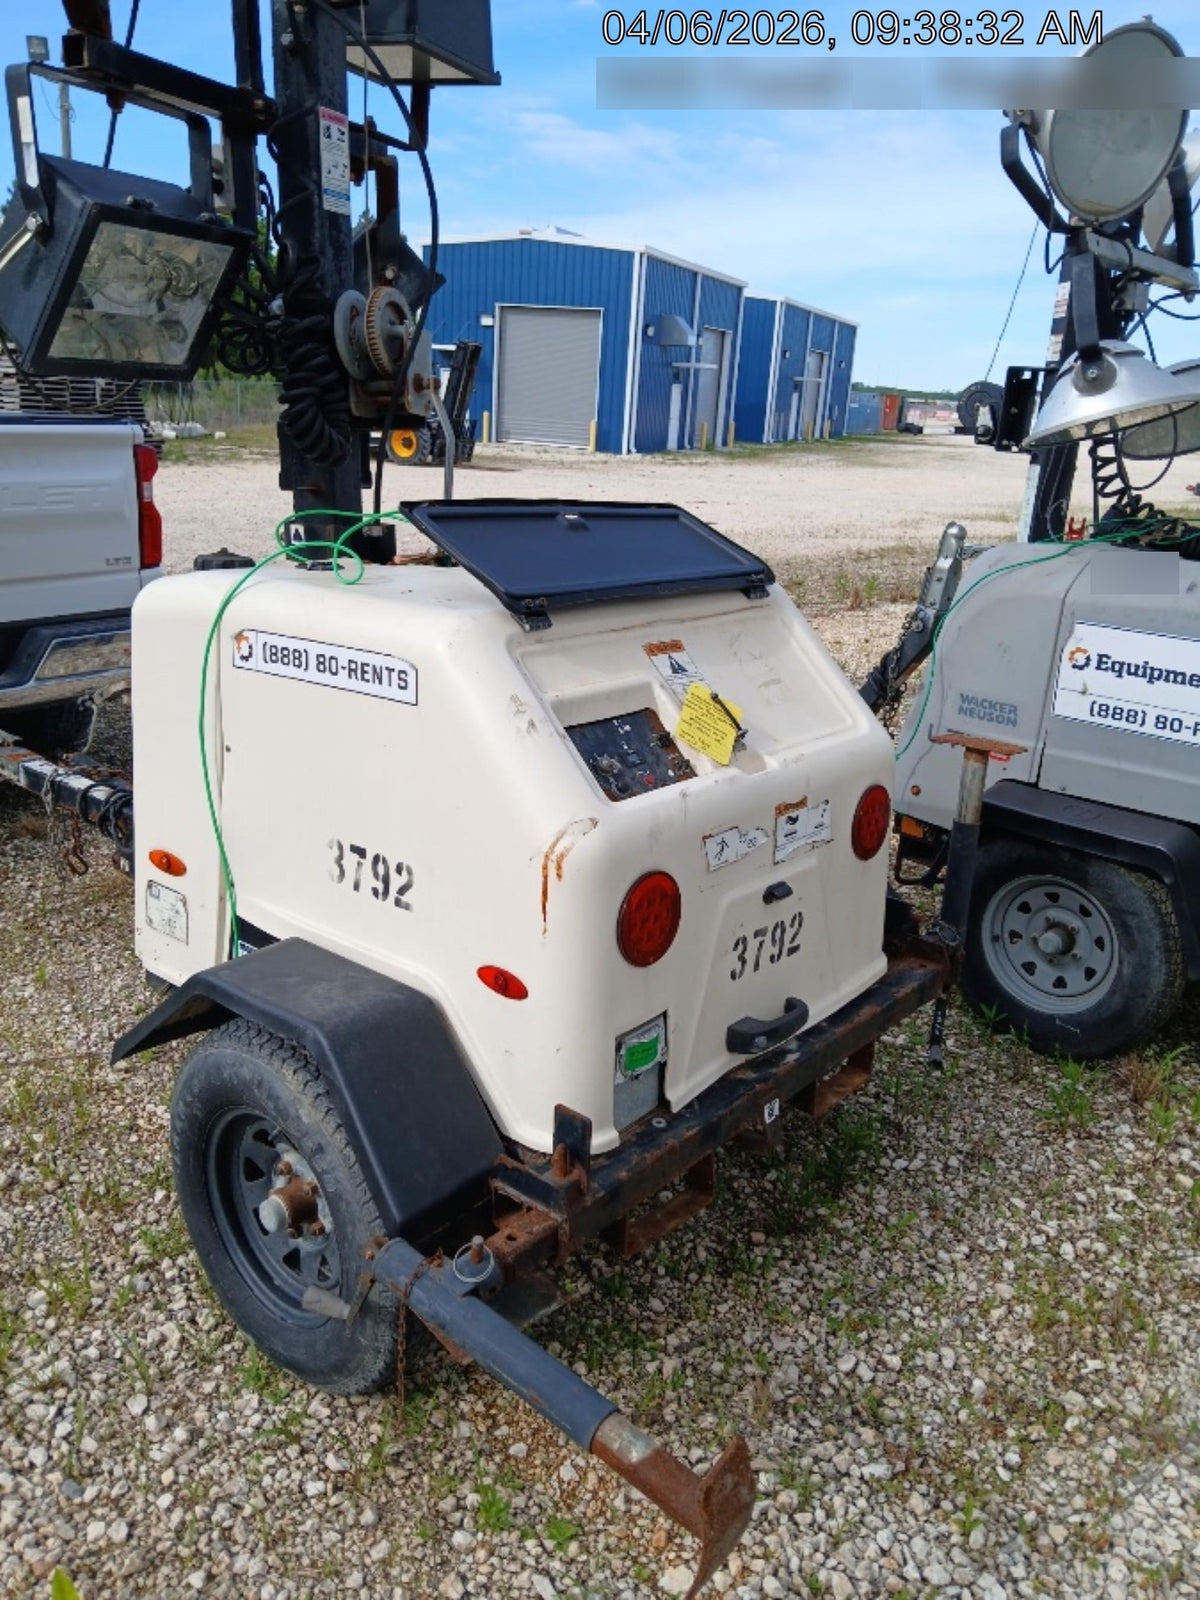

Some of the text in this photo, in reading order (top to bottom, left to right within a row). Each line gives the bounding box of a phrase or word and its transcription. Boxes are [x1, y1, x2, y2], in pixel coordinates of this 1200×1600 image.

[262, 641, 409, 691] (888) 80-RENTS
[958, 705, 1018, 728] NEUSON
[959, 693, 1018, 718] WACKER
[1089, 700, 1148, 727] (888)
[327, 837, 415, 912] 3792
[730, 911, 804, 981] 3792
